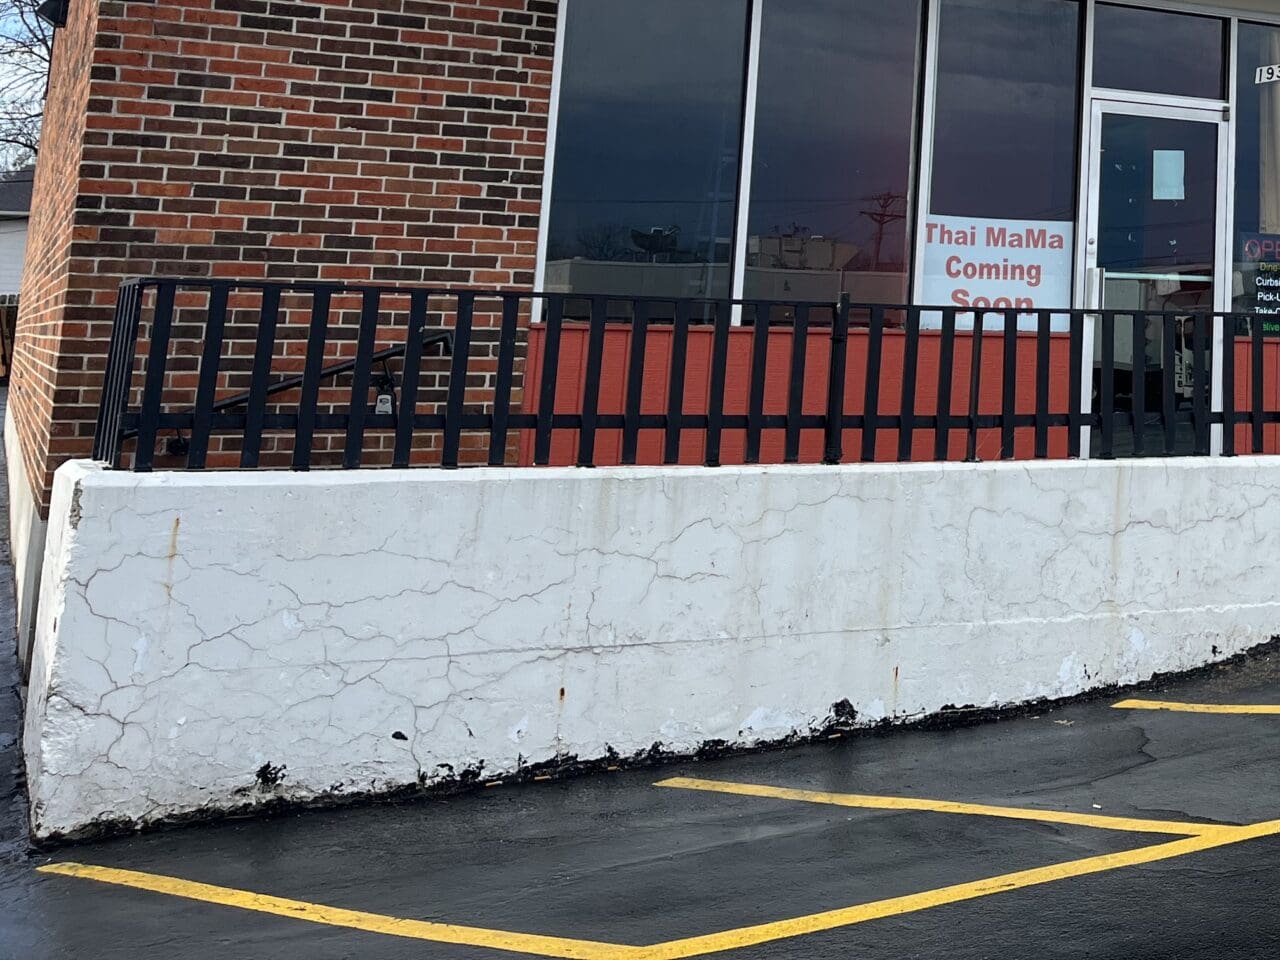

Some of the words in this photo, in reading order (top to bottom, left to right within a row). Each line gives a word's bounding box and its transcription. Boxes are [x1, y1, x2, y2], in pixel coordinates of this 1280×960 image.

[925, 222, 976, 246] Thai
[985, 226, 1065, 250] MaMa
[945, 255, 1042, 287] Coming
[951, 289, 1035, 315] Soon
